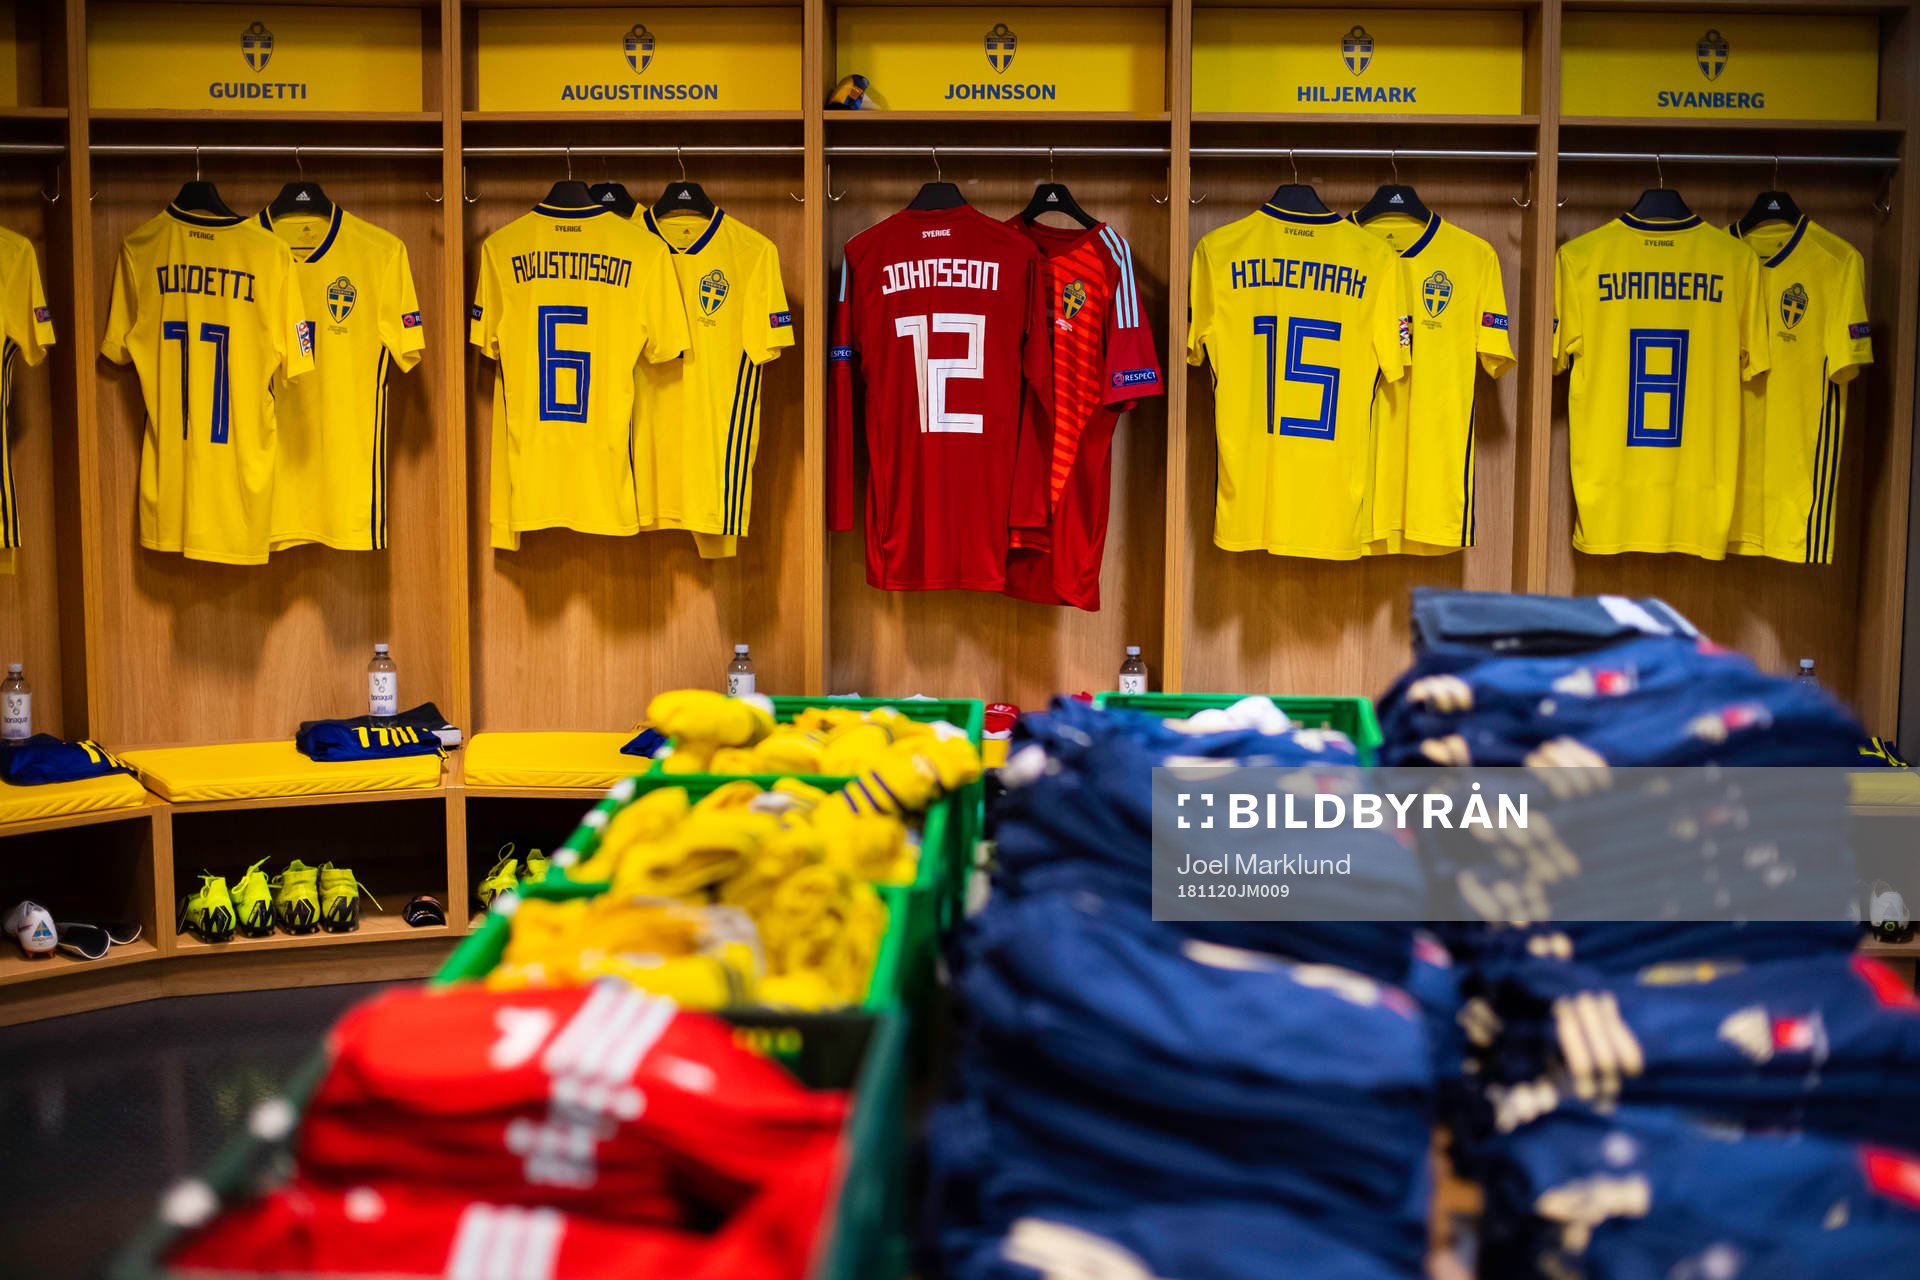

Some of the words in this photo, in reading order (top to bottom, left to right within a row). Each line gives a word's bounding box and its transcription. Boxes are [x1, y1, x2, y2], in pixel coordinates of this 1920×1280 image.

[209, 82, 307, 99] GUIDETTI
[561, 84, 718, 100] AUGUSTINSSON
[944, 83, 1056, 100] JOHNSSON
[1297, 86, 1417, 103] HILJEMARK
[1657, 91, 1765, 109] SVANBERG
[188, 230, 215, 241] SVERIGE
[921, 228, 951, 238] SVERIGE
[1284, 227, 1315, 238] SVERIGE
[1644, 239, 1675, 247] SVERIGE
[881, 258, 999, 295] JOHNSSON
[1231, 257, 1367, 299] HILJEMARK
[1598, 271, 1724, 303] SVANBERG
[538, 305, 591, 424] 6
[895, 312, 986, 434] 12
[163, 320, 230, 444] 11
[1124, 372, 1156, 383] RESPECT
[1253, 315, 1342, 441] 15
[1626, 328, 1690, 448] 8
